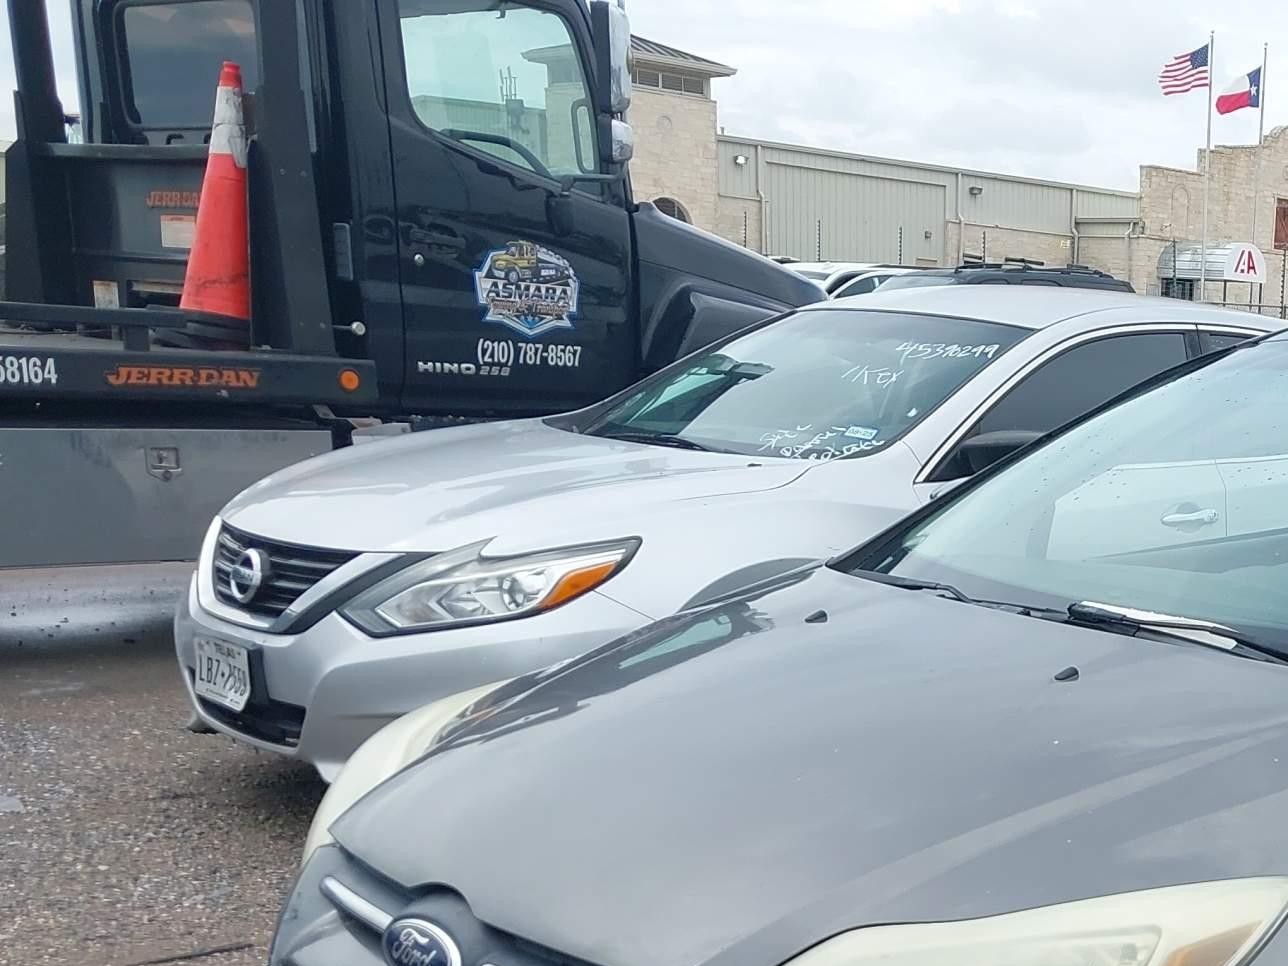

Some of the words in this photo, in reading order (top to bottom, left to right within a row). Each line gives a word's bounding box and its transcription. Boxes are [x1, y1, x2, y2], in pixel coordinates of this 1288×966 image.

[486, 281, 569, 305] ASMARA
[477, 337, 514, 366] (210)
[517, 342, 582, 368] 787-8567
[417, 360, 476, 376] HINO
